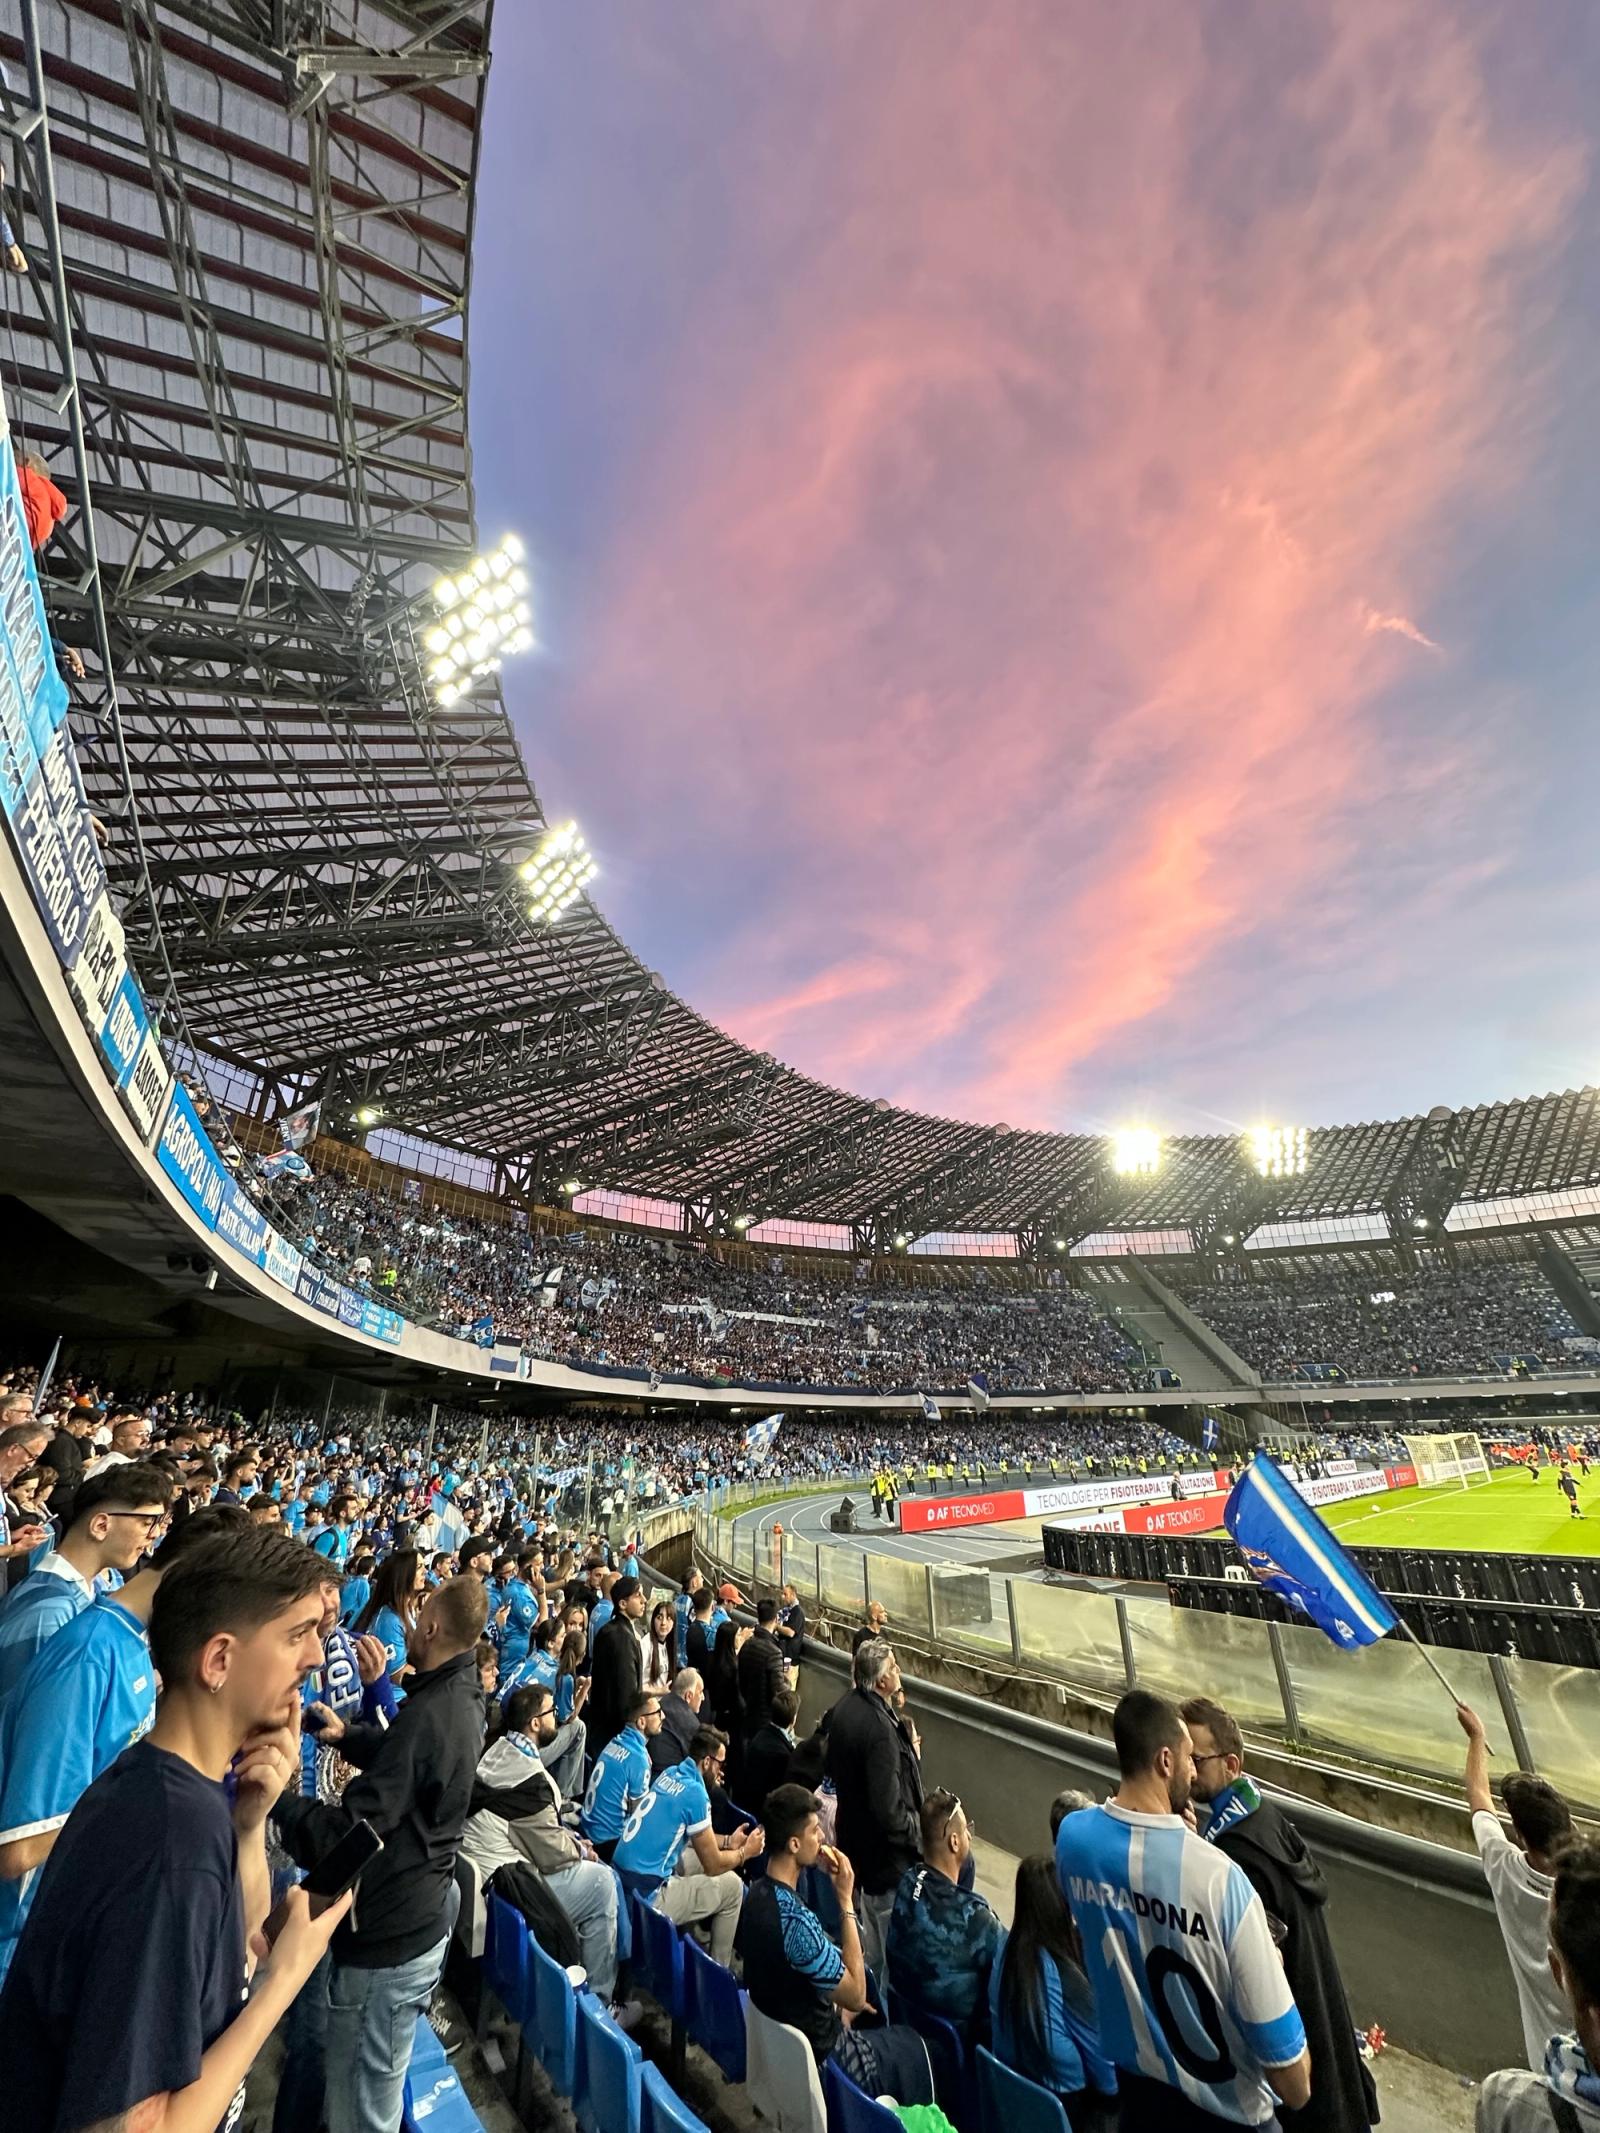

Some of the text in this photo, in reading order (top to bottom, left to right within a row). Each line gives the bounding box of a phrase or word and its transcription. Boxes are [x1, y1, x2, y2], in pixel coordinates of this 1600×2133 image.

[21, 784, 80, 947] PINEROLO
[73, 835, 100, 905] CLUB
[134, 1049, 162, 1118] AMORE
[162, 1104, 207, 1195] AGROPOLI
[937, 1502, 995, 1520] AF TECNOMED
[1037, 1489, 1092, 1509] TECNOLOGIE
[1094, 1487, 1109, 1500] PER
[1111, 1482, 1160, 1497] FISIOTERAPIA
[1312, 1482, 1349, 1500] FISIOTERAPIA
[1353, 1475, 1386, 1490] RIABILITAZIONE
[1155, 1507, 1205, 1530] AF TECNOMED
[585, 1761, 605, 1815] 8
[623, 1792, 657, 1842] 8
[1070, 1876, 1210, 1941] MARADONA
[1102, 1926, 1237, 2084] 10
